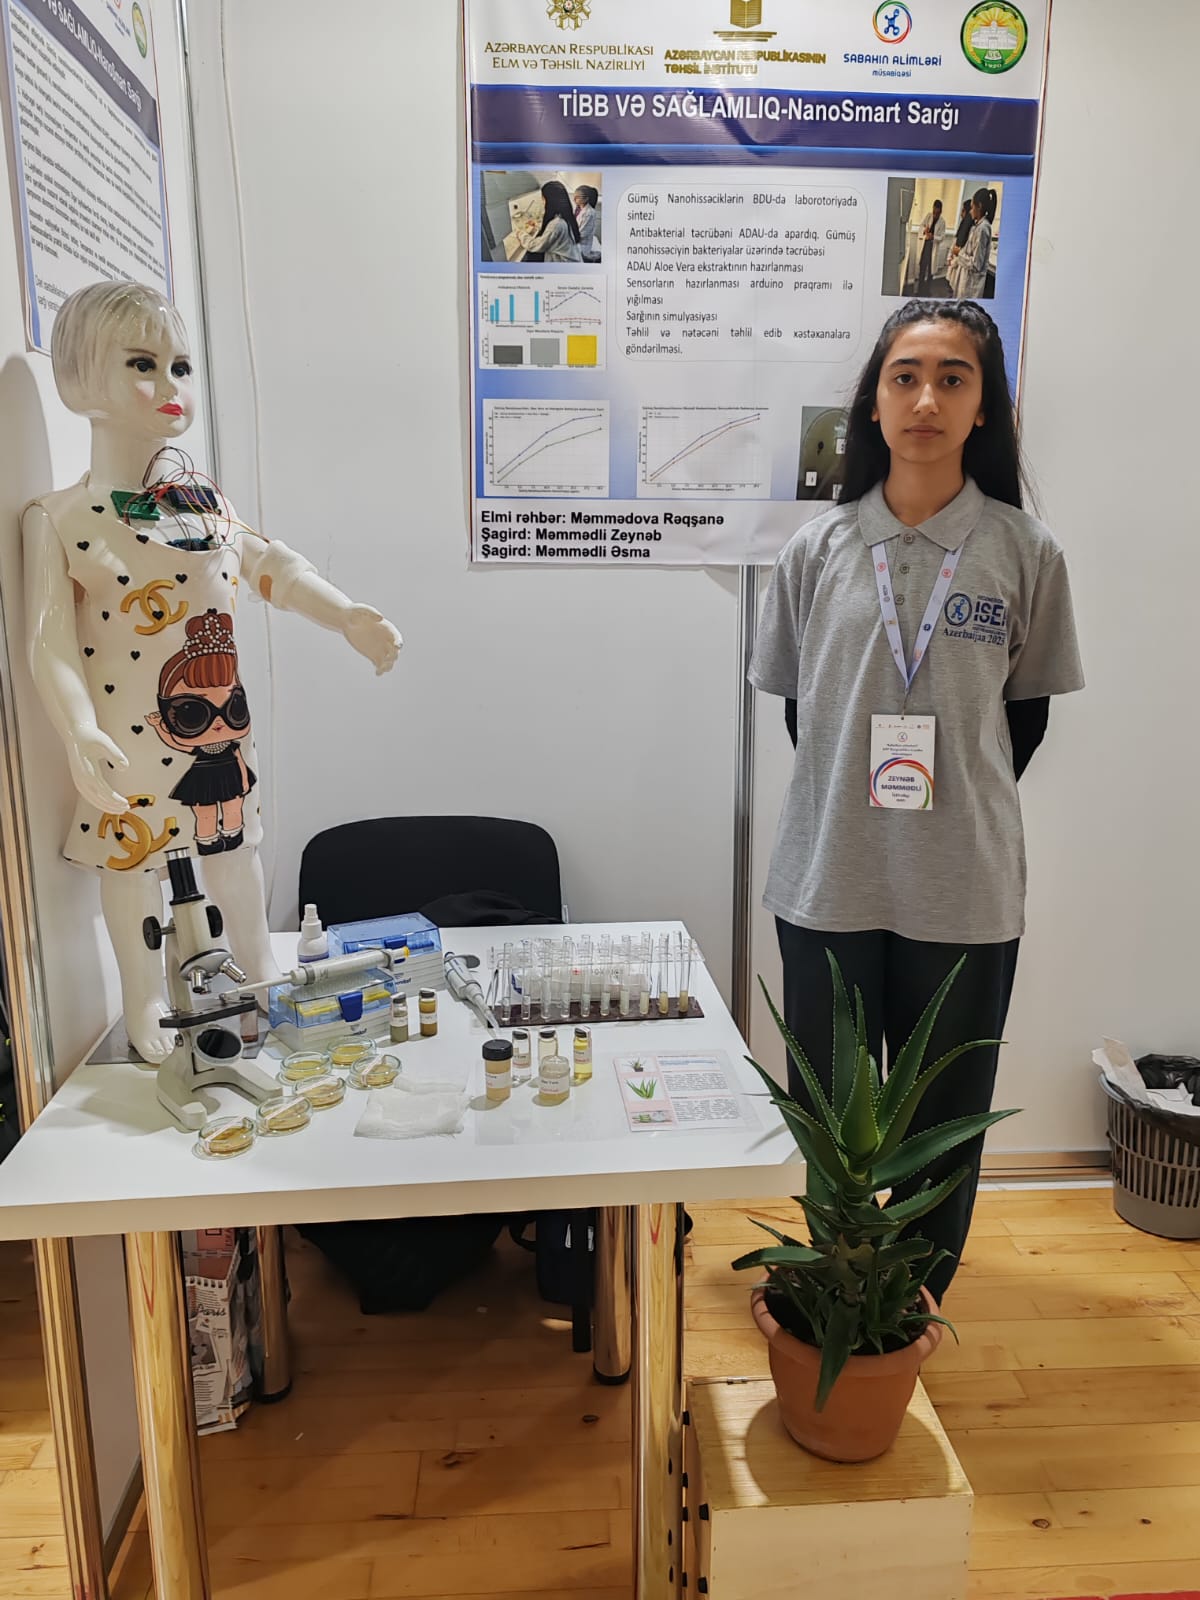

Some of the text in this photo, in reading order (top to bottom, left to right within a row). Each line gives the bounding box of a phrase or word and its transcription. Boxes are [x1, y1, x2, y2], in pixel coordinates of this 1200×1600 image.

[484, 42, 654, 55] AZƏRBAYCAN RESPUBLİKASI
[664, 49, 826, 64] AZƏRBAYCAN RESPUBLİKASININ
[843, 53, 889, 65] SABAHIN
[492, 57, 519, 69] ELM
[540, 58, 583, 70] TƏHSİL
[664, 63, 702, 74] TƏHSİL
[558, 88, 959, 131] TİBB VƏ SAĞLAMLIQ-NanoSmart Sarğı
[627, 193, 659, 206] Gümüş
[667, 193, 744, 204] Nanohissəciklərin
[753, 193, 786, 205] BDU-da
[627, 210, 655, 221] sintezi
[629, 227, 685, 238] Antibakterial
[691, 228, 733, 238] təcrübəni
[738, 228, 779, 239] ADAU-da
[825, 229, 856, 243] Gümüş
[692, 245, 744, 257] bakteriyalar
[746, 245, 783, 256] üzərində
[786, 246, 825, 257] təcrübəsi
[627, 261, 652, 271] ADAU
[654, 261, 674, 271] Aloe
[676, 262, 695, 272] Vera
[626, 278, 675, 288] Sensorların
[750, 278, 784, 289] arduino
[842, 280, 853, 290] ilə
[626, 326, 649, 337] Təhlil
[730, 327, 752, 337] təhlil
[763, 328, 783, 338] edib
[481, 511, 724, 528] Elmi rəhbər: Məmmədova Rəqşanə
[481, 528, 662, 544] Şagird: Məmmədli Zeynəb
[481, 544, 650, 559] Şagird: Məmmədli Əsma
